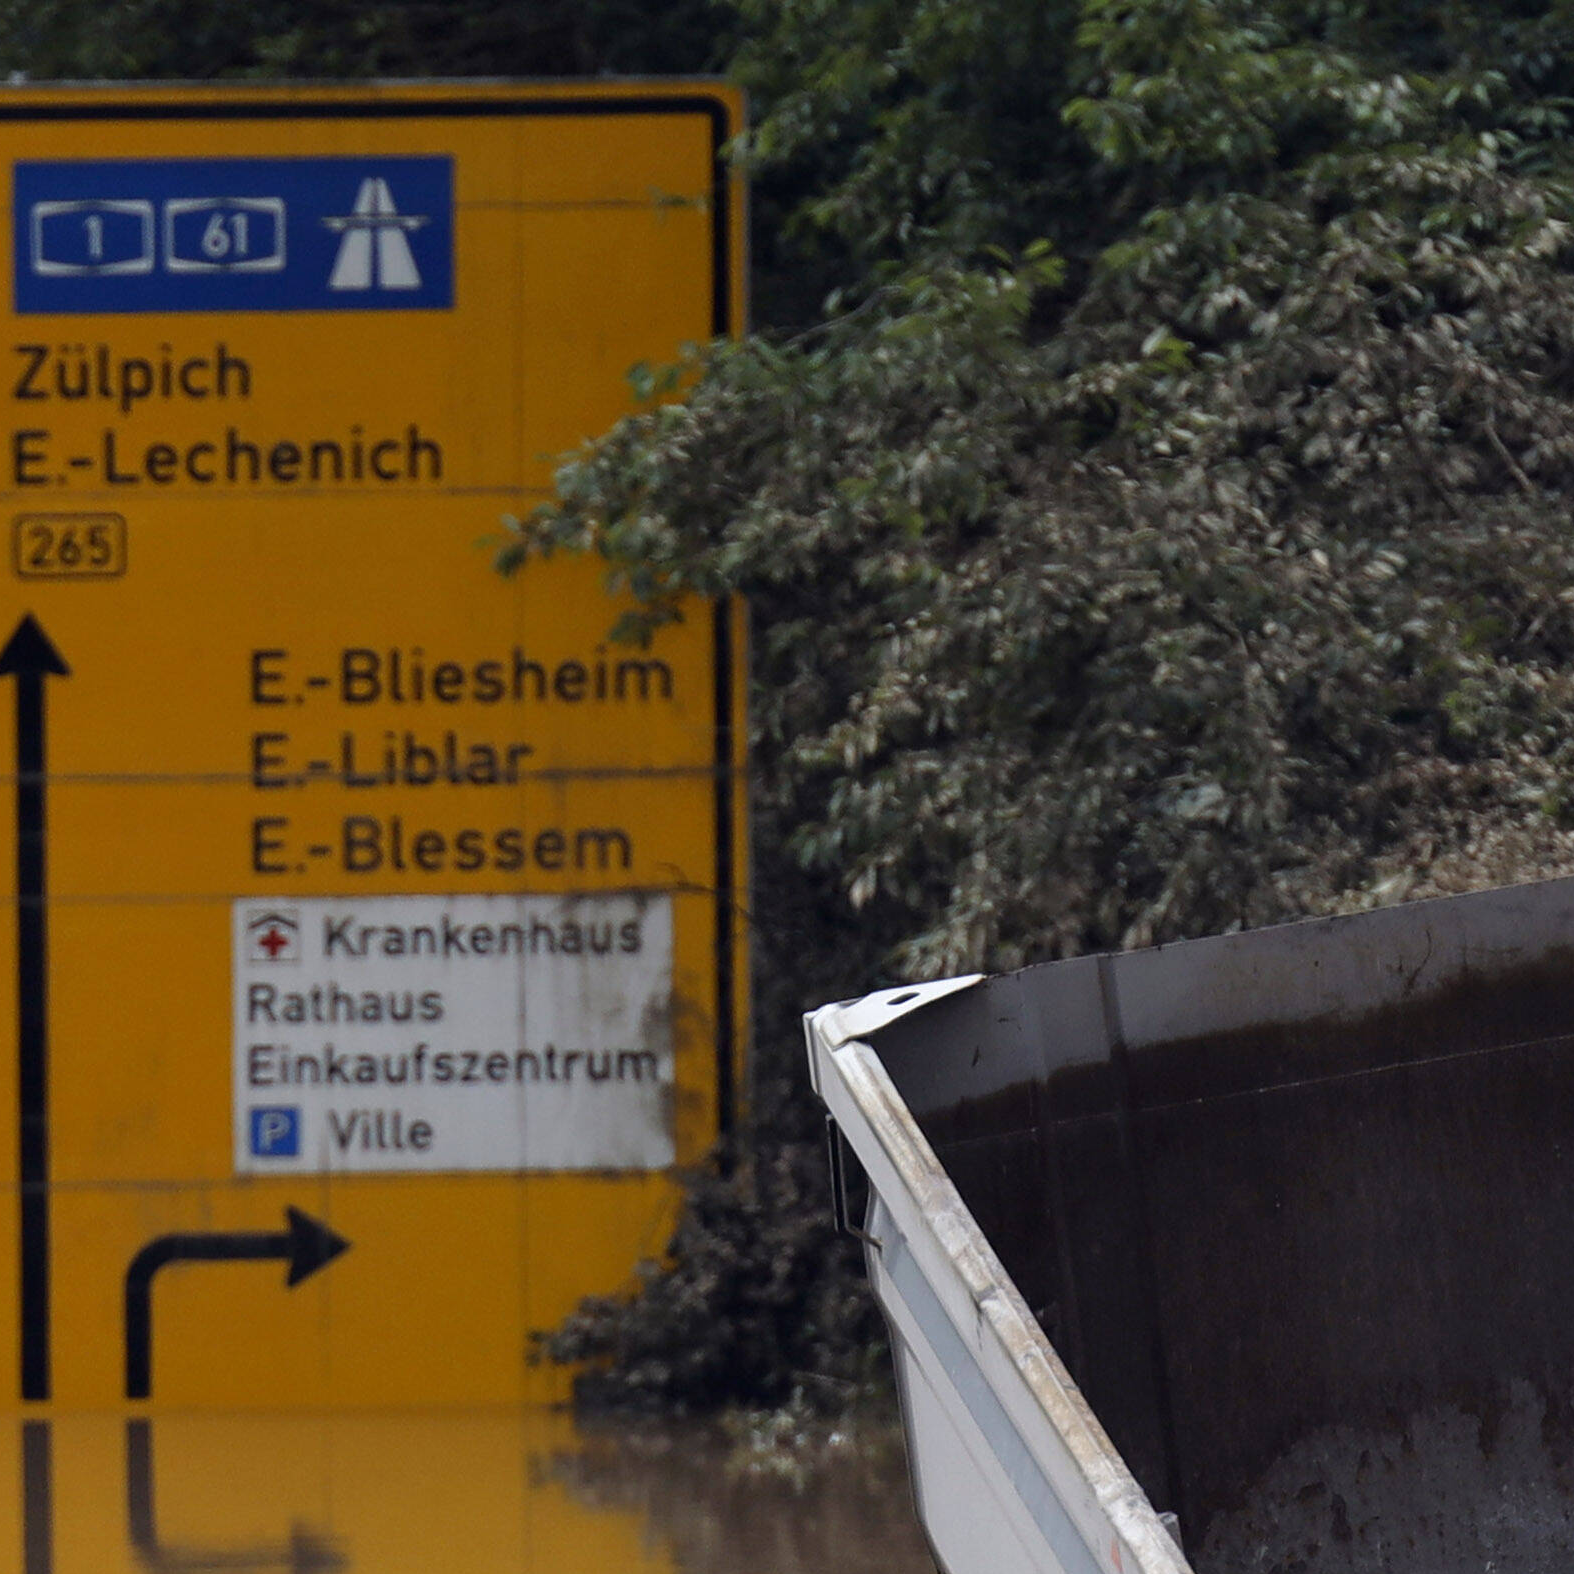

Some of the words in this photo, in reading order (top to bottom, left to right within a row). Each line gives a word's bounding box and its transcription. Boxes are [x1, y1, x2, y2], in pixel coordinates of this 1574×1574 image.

[83, 213, 105, 260] 1
[201, 212, 249, 259] 61
[12, 343, 253, 416] Zülpich
[11, 422, 445, 486] E.-Lechenich
[27, 524, 113, 568] 265
[251, 645, 675, 706] E.-Bliesheim
[252, 729, 535, 789] E.-Liblar
[252, 814, 633, 874] E.-Blessem
[324, 913, 645, 958] Krankenhaus
[247, 981, 445, 1025] Rathaus
[247, 1042, 661, 1087] Einkaufszentrum
[257, 1111, 293, 1152] P
[328, 1109, 434, 1152] Ville
